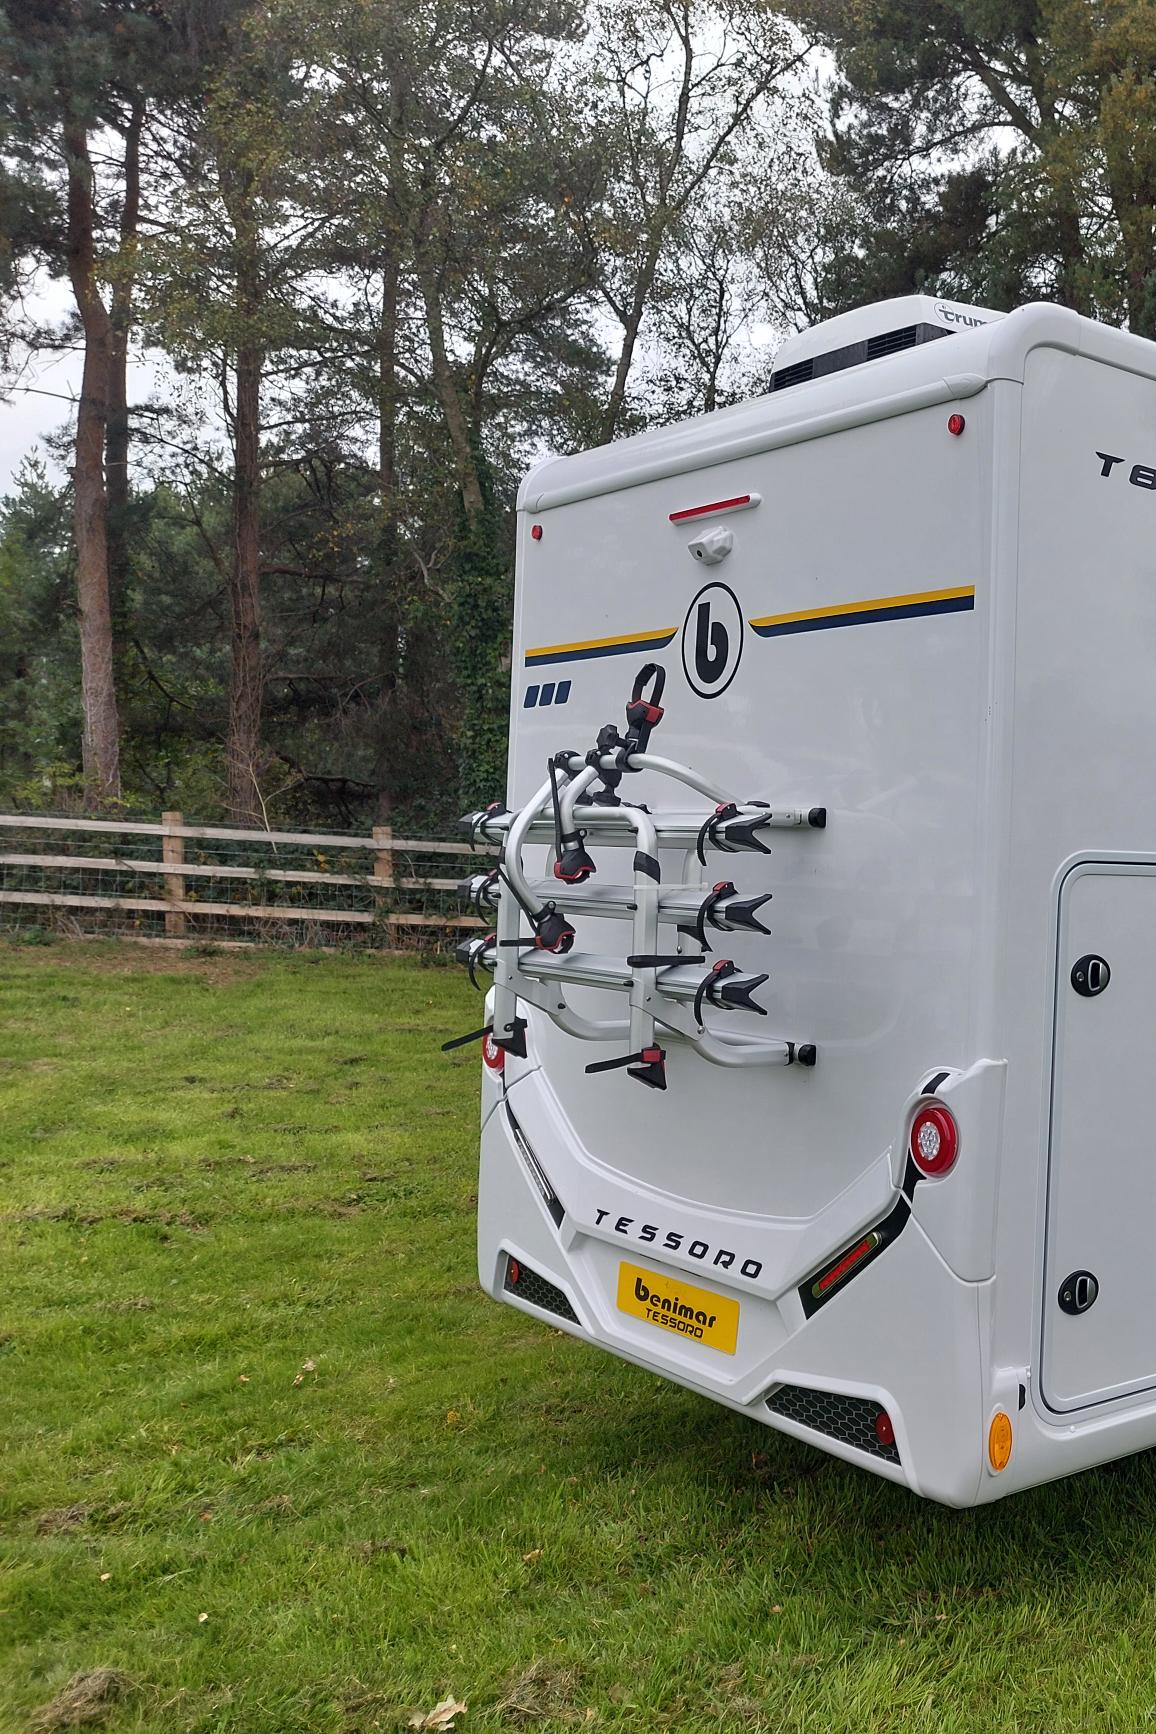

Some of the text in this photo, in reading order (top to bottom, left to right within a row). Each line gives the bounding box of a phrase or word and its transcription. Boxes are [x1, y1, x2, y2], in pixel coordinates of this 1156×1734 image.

[1095, 451, 1126, 478] T
[695, 601, 729, 684] b
[595, 1208, 763, 1279] TESSORO
[634, 1276, 718, 1328] benimar
[645, 1307, 704, 1339] TESSORO
